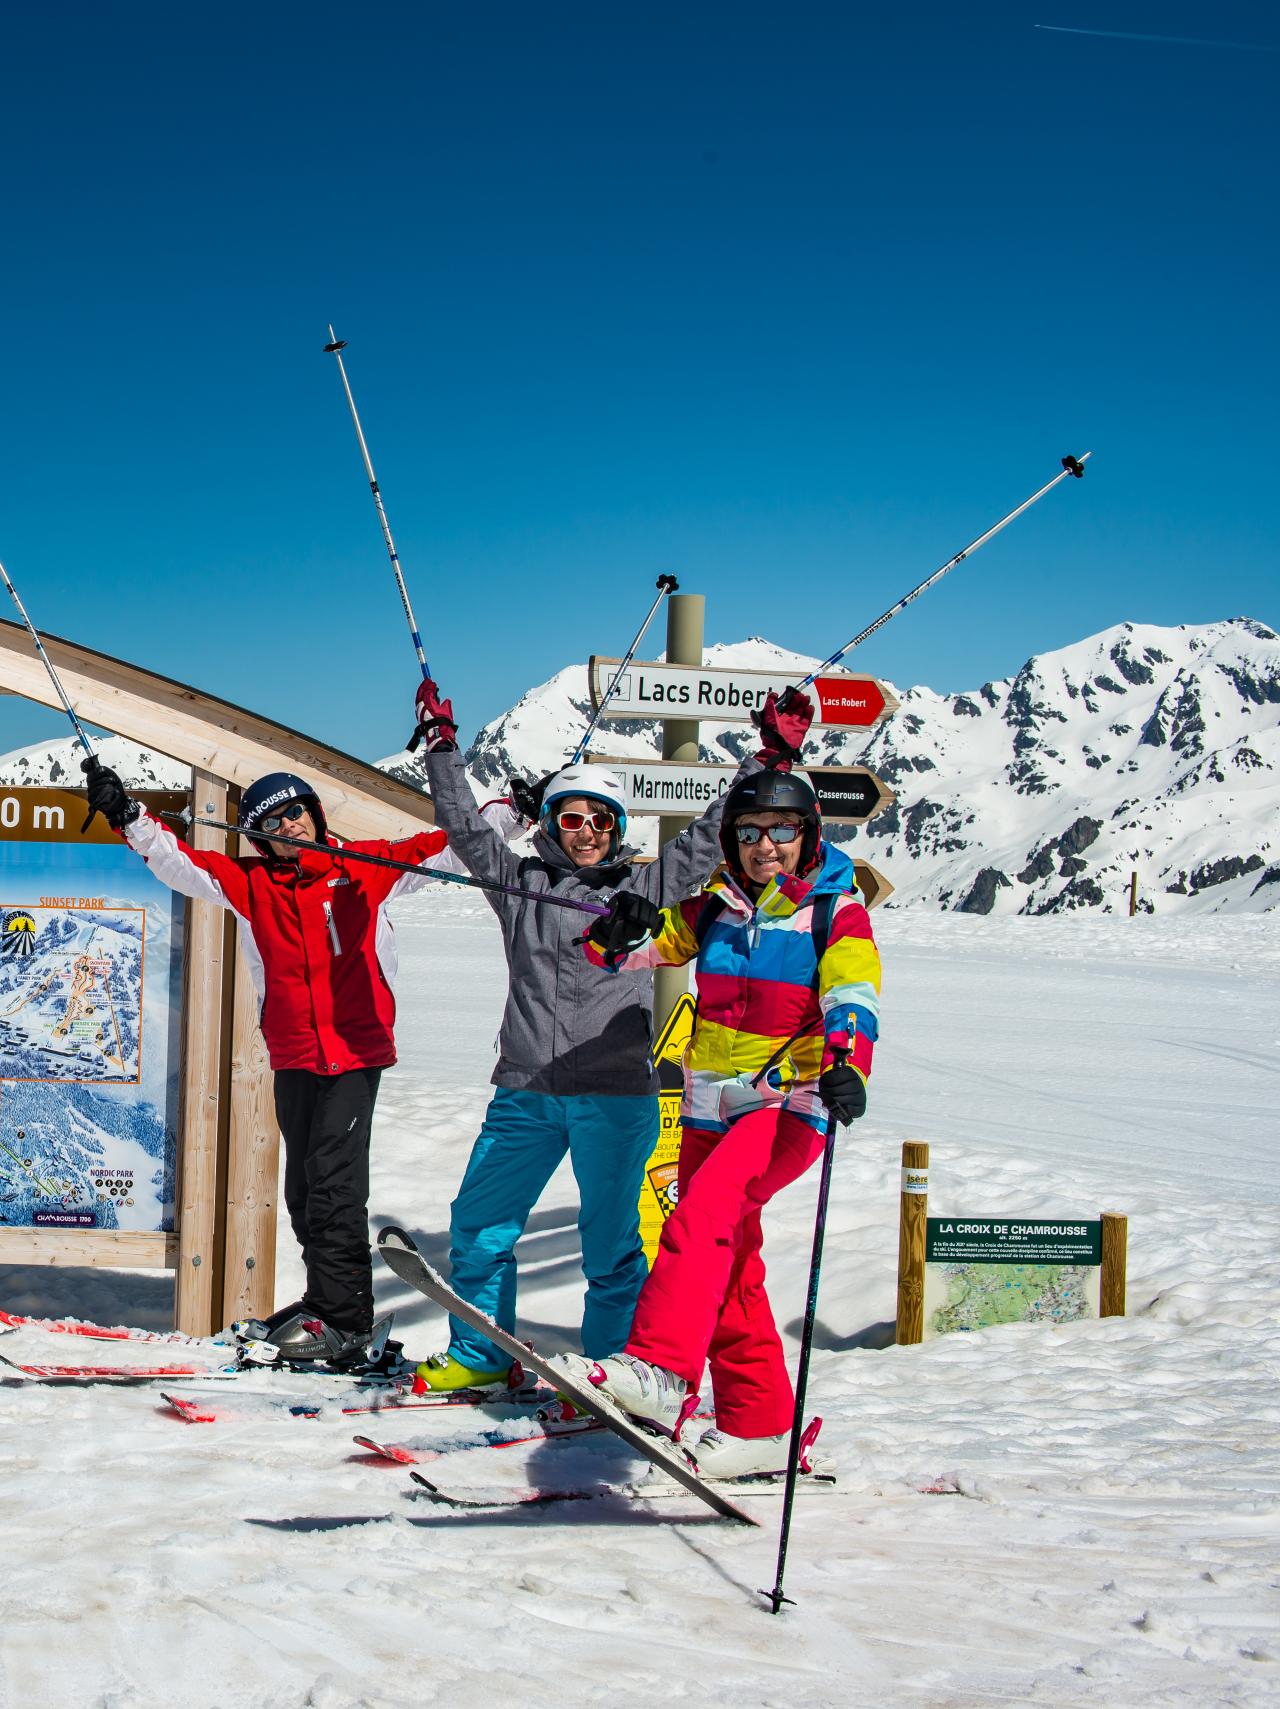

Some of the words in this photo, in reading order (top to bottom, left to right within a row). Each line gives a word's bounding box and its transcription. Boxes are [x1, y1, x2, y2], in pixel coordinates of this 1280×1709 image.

[638, 677, 690, 702] Lacs
[698, 680, 773, 708] Rober
[823, 697, 840, 706] Lacs
[841, 698, 866, 707] Robert
[633, 774, 735, 800] Marmottes-C
[818, 790, 864, 800] Casserousse
[32, 804, 65, 829] m
[40, 897, 76, 908] SUNSET
[79, 898, 104, 909] PARK
[90, 1169, 115, 1177] NORDIC
[116, 1170, 134, 1178] PARK
[37, 1214, 77, 1222] CHAMROUSSE
[939, 1224, 953, 1233] LA
[956, 1224, 991, 1234] CROIX
[993, 1225, 1008, 1234] DE
[1010, 1226, 1088, 1236] CHAMROUSSE
